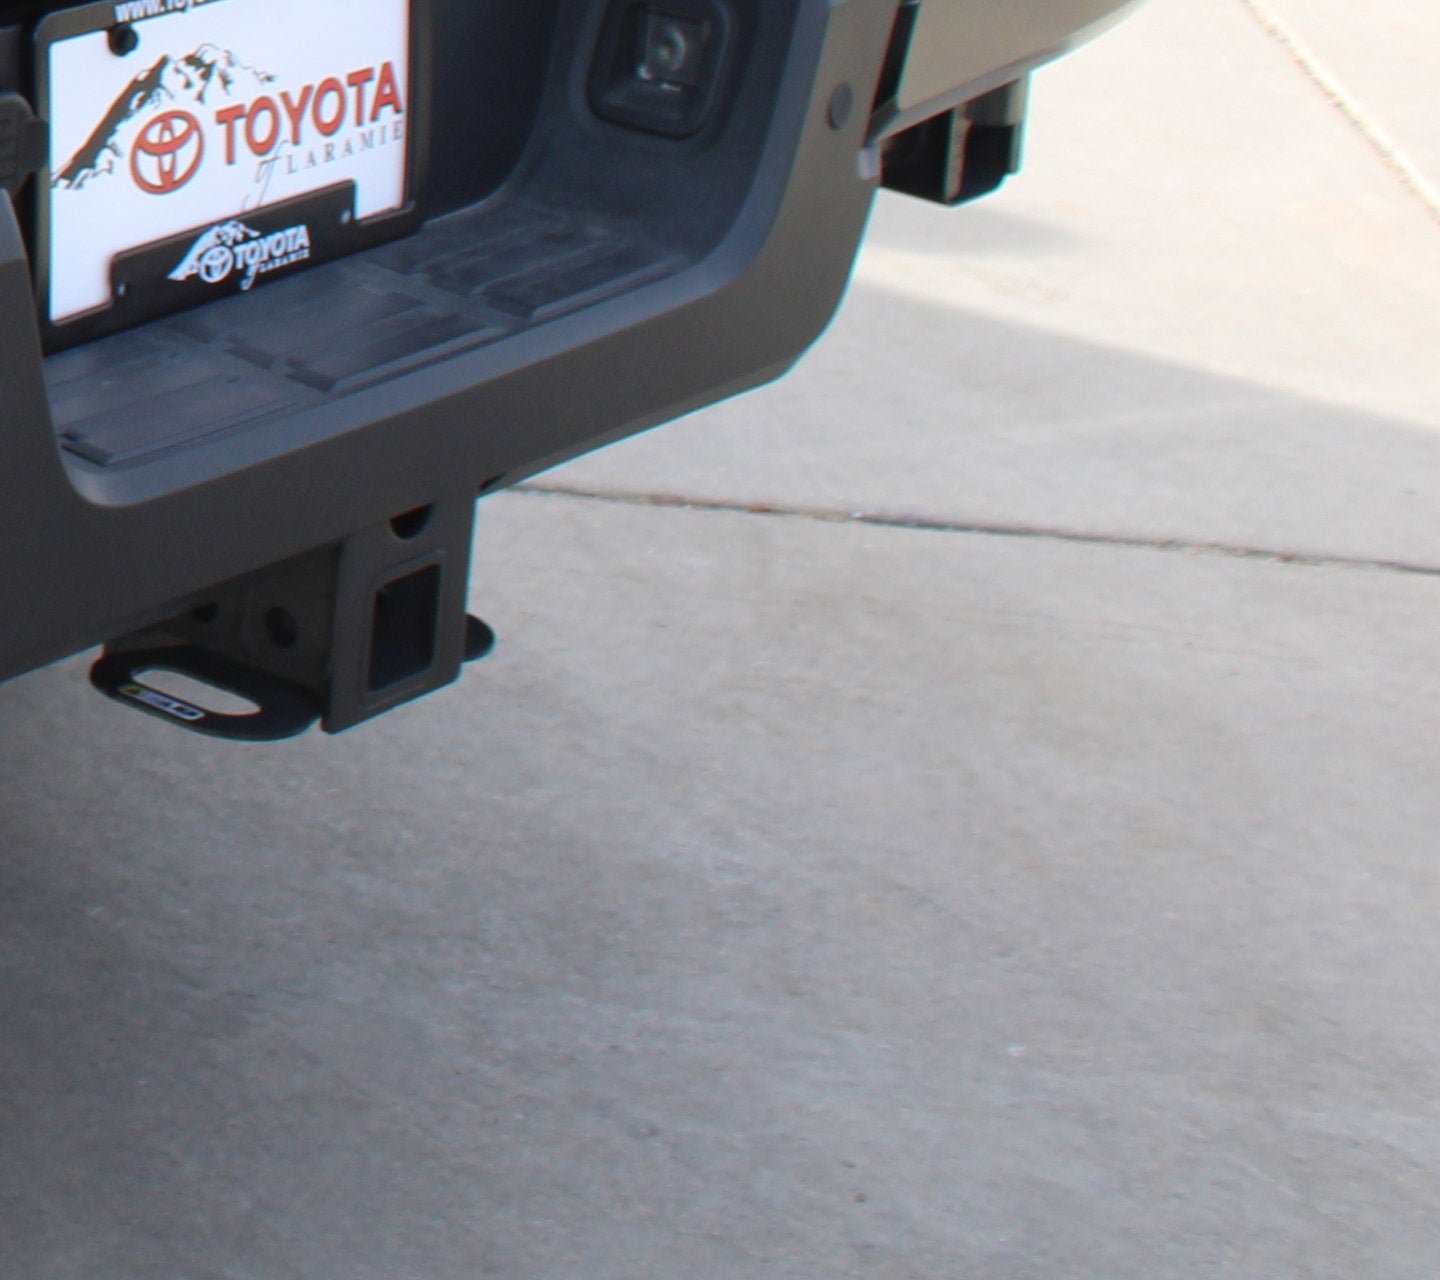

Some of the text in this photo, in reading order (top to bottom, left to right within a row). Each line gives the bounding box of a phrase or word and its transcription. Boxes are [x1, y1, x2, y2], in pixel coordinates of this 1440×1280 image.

[214, 60, 405, 166] TOYOTA
[285, 118, 406, 175] LARAMIE
[232, 224, 311, 270] TOYOTA
